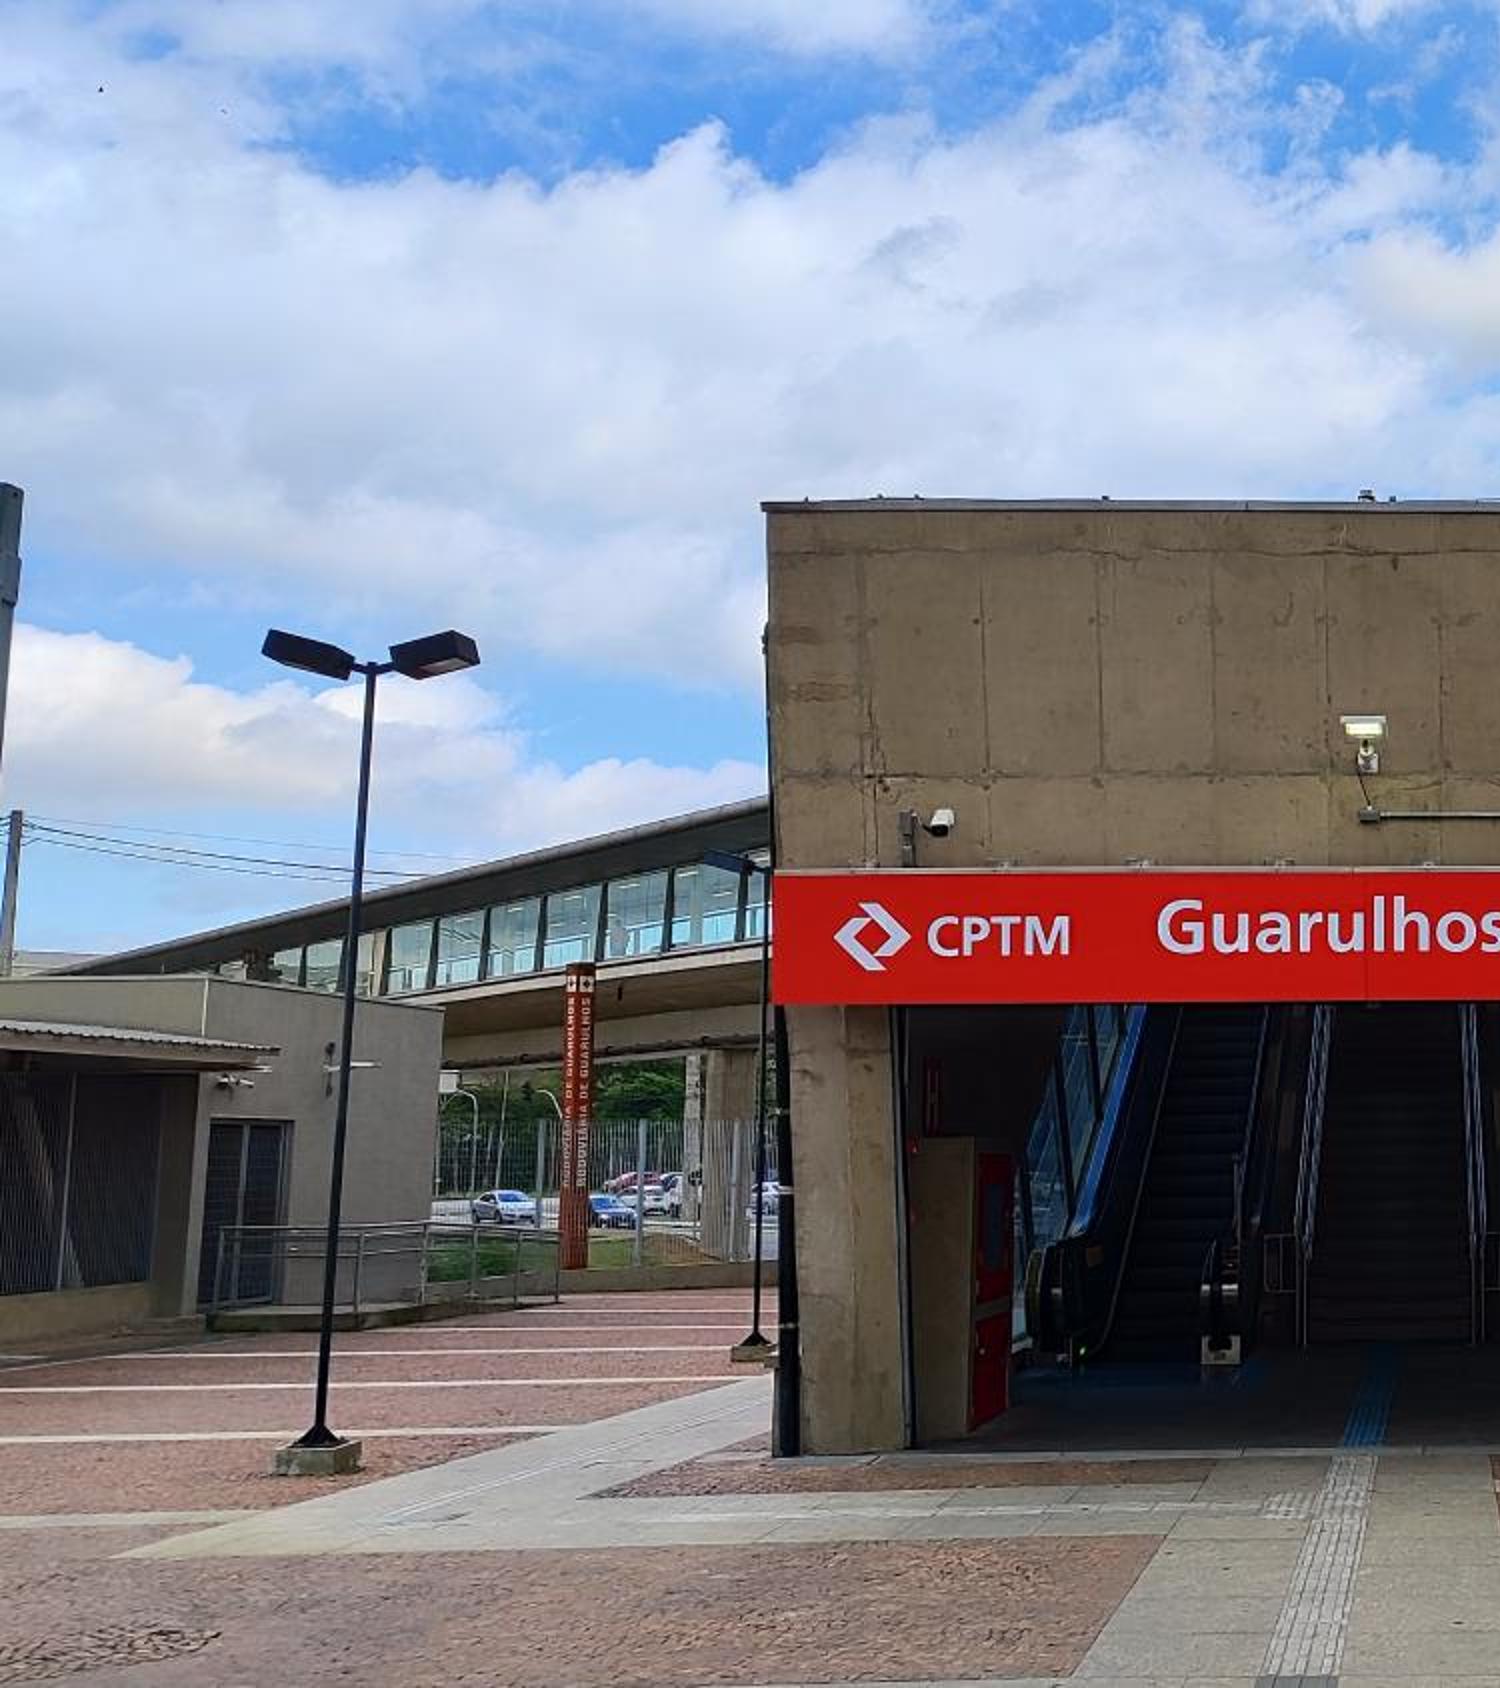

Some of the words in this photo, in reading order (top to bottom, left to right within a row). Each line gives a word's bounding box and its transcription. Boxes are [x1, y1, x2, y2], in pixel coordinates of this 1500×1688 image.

[926, 915, 1070, 957] CPTM
[580, 997, 591, 1078] GUARULHOS
[565, 1082, 574, 1098] DE
[580, 1082, 589, 1098] DE
